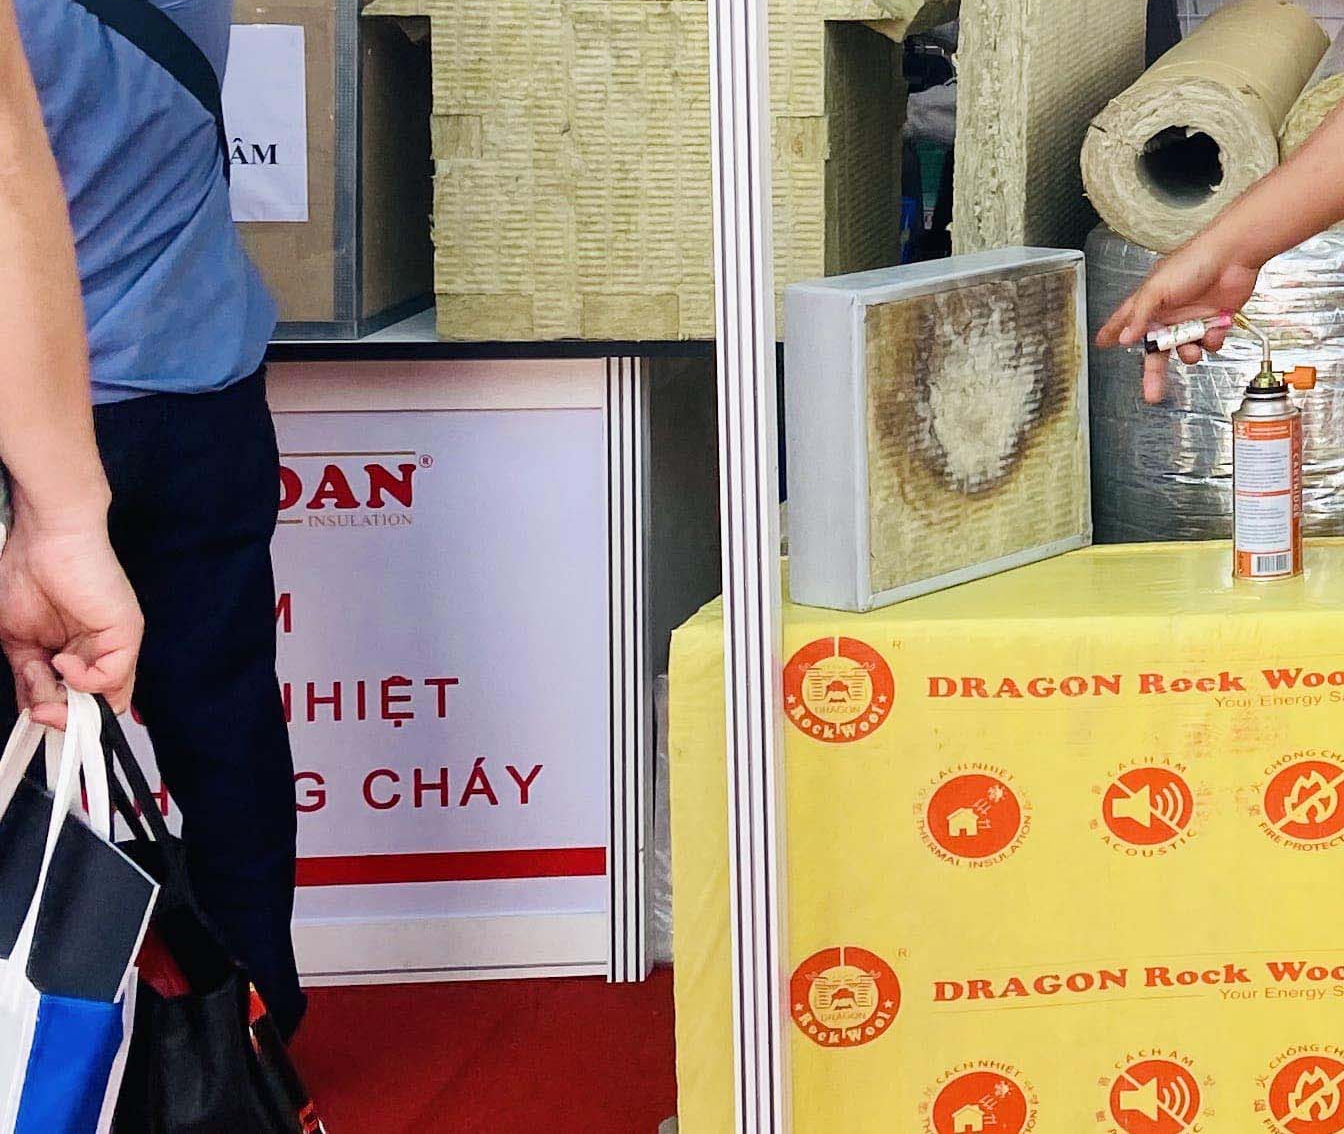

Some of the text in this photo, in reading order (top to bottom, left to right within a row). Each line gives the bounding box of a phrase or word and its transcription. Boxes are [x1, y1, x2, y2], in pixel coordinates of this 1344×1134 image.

[308, 513, 413, 528] INSULATION
[926, 674, 1122, 699] DRAGON
[1138, 671, 1246, 695] Rock
[1260, 694, 1322, 708] Energy
[363, 757, 543, 810] CHÁY
[933, 968, 1128, 1002] DRAGON
[1144, 963, 1251, 988] Rock
[1219, 987, 1258, 1000] Your
[1265, 986, 1325, 1001] Energy
